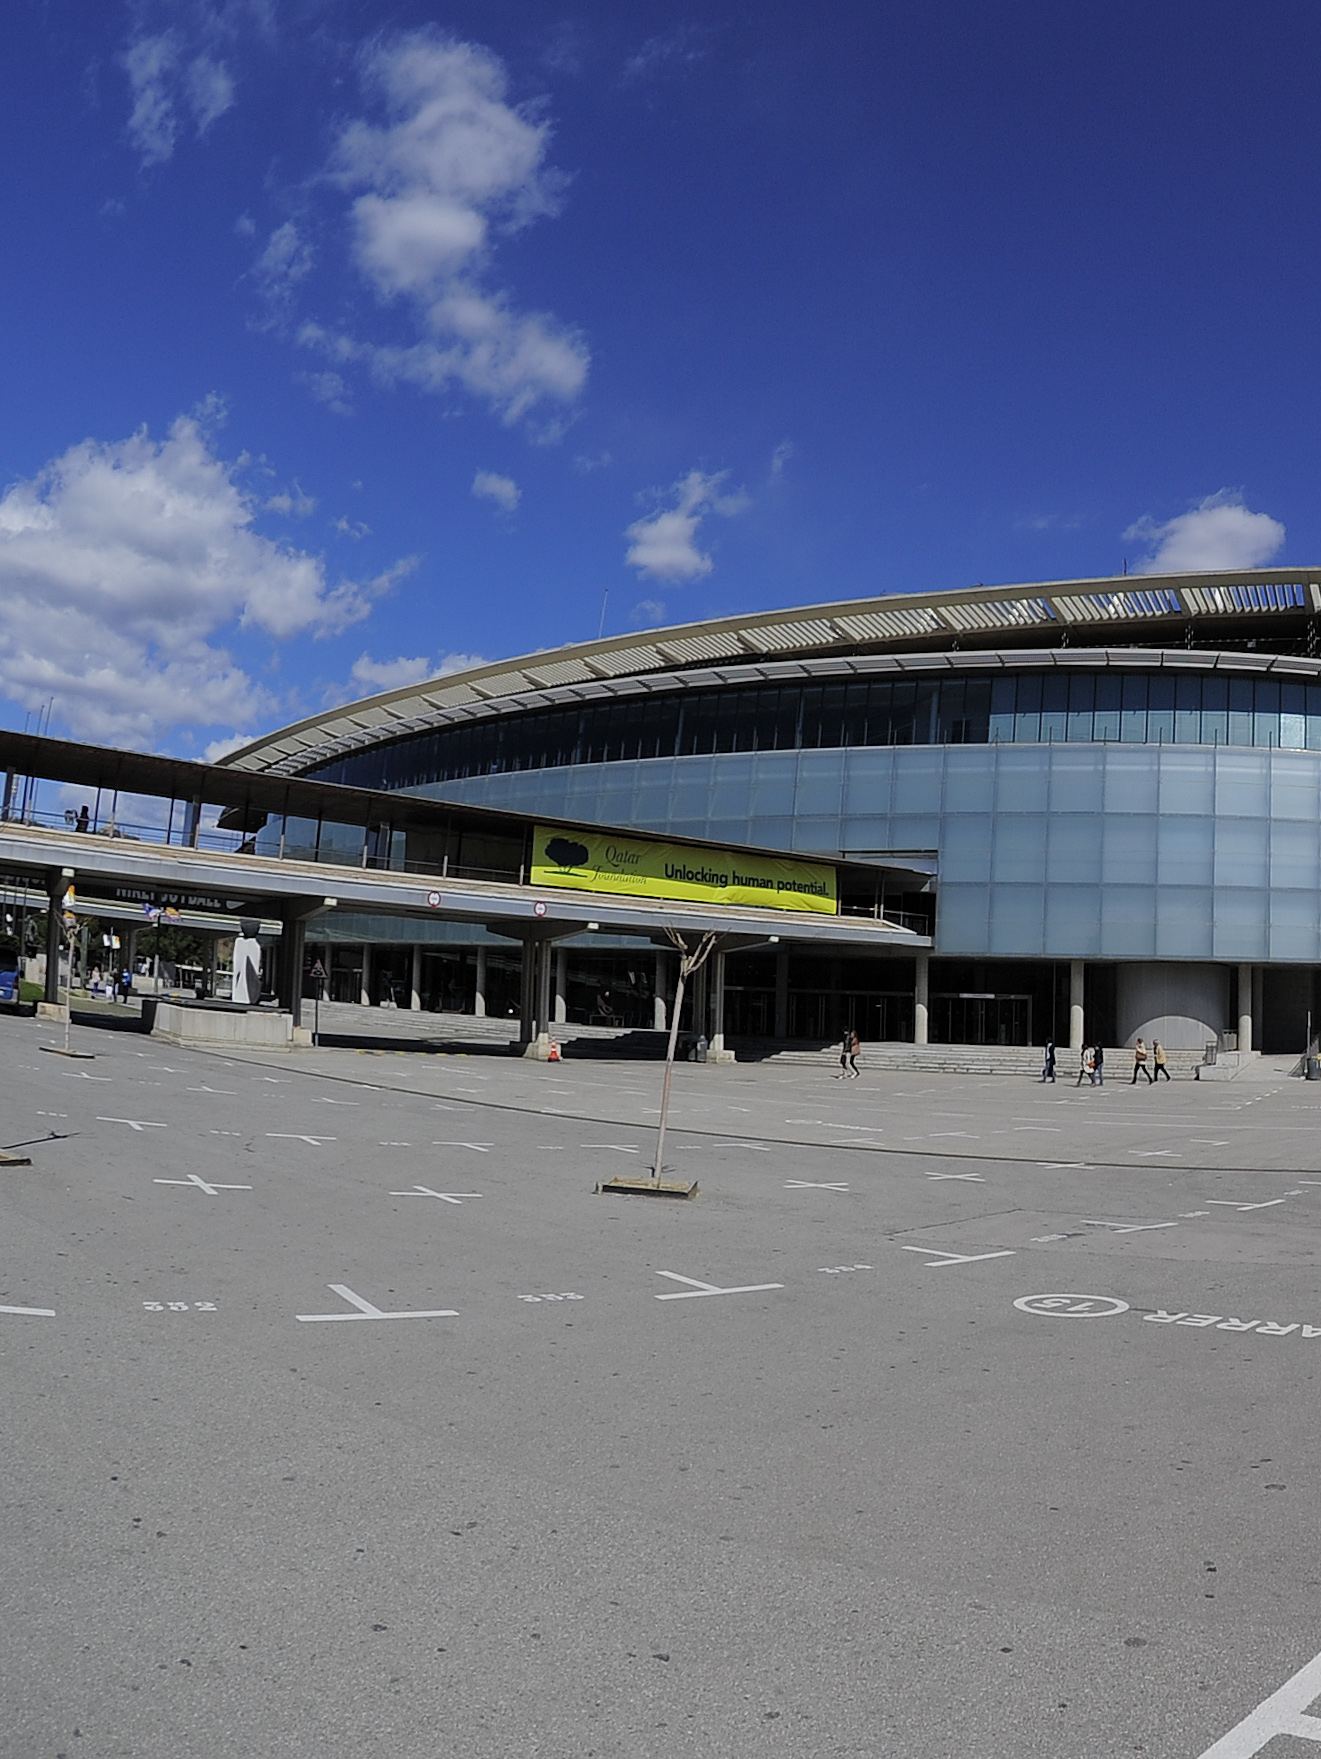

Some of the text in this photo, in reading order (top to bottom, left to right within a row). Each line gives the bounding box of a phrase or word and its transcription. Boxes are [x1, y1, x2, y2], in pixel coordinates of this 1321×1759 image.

[605, 845, 642, 867] Qatar
[664, 862, 829, 896] Unlocking human potential.
